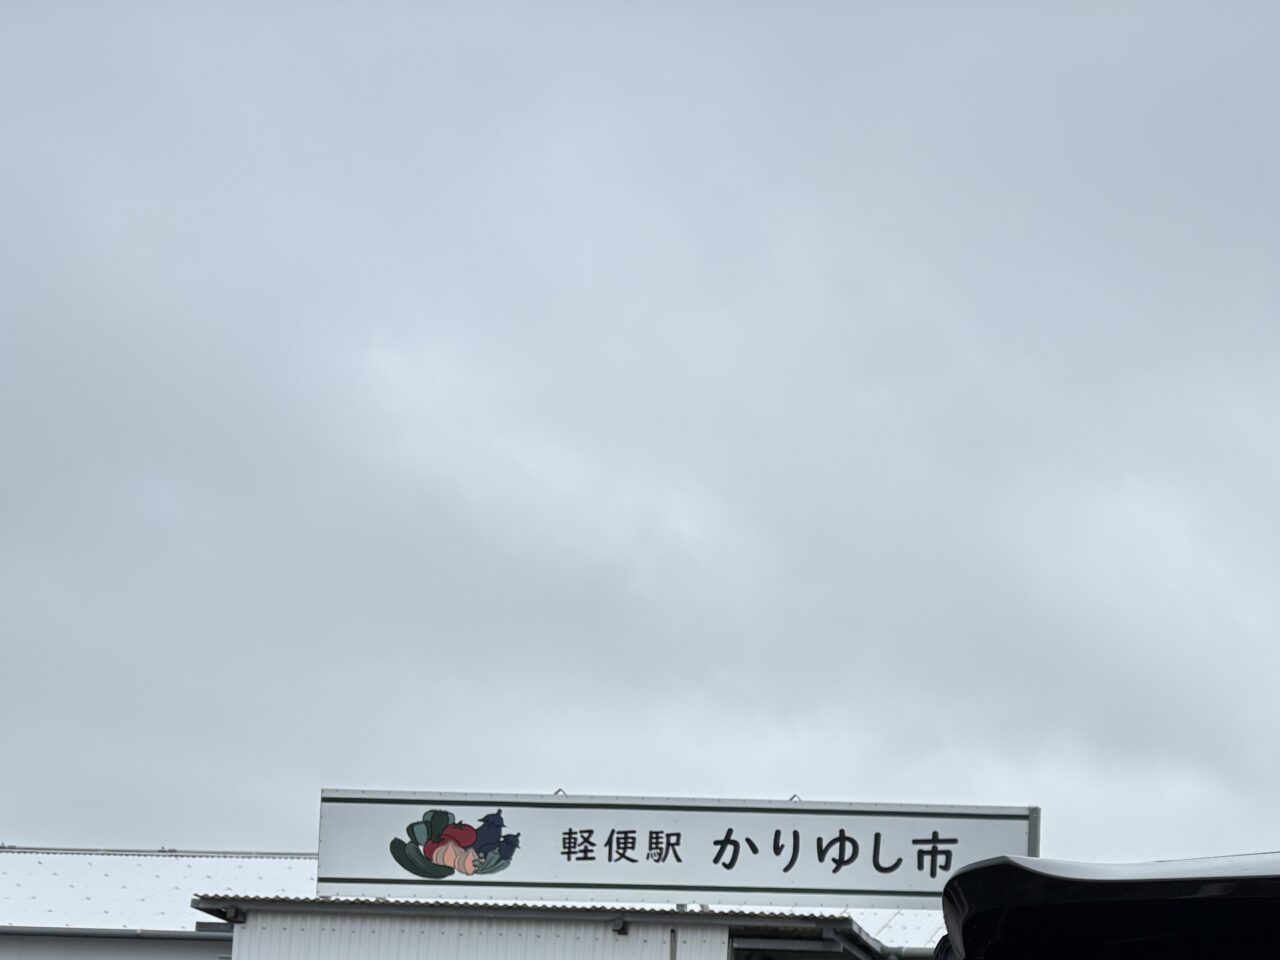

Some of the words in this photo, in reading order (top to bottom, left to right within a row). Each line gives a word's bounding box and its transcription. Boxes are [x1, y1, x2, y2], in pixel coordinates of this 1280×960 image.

[561, 828, 683, 863] 軽便駅
[712, 828, 958, 878] かりゆし市
